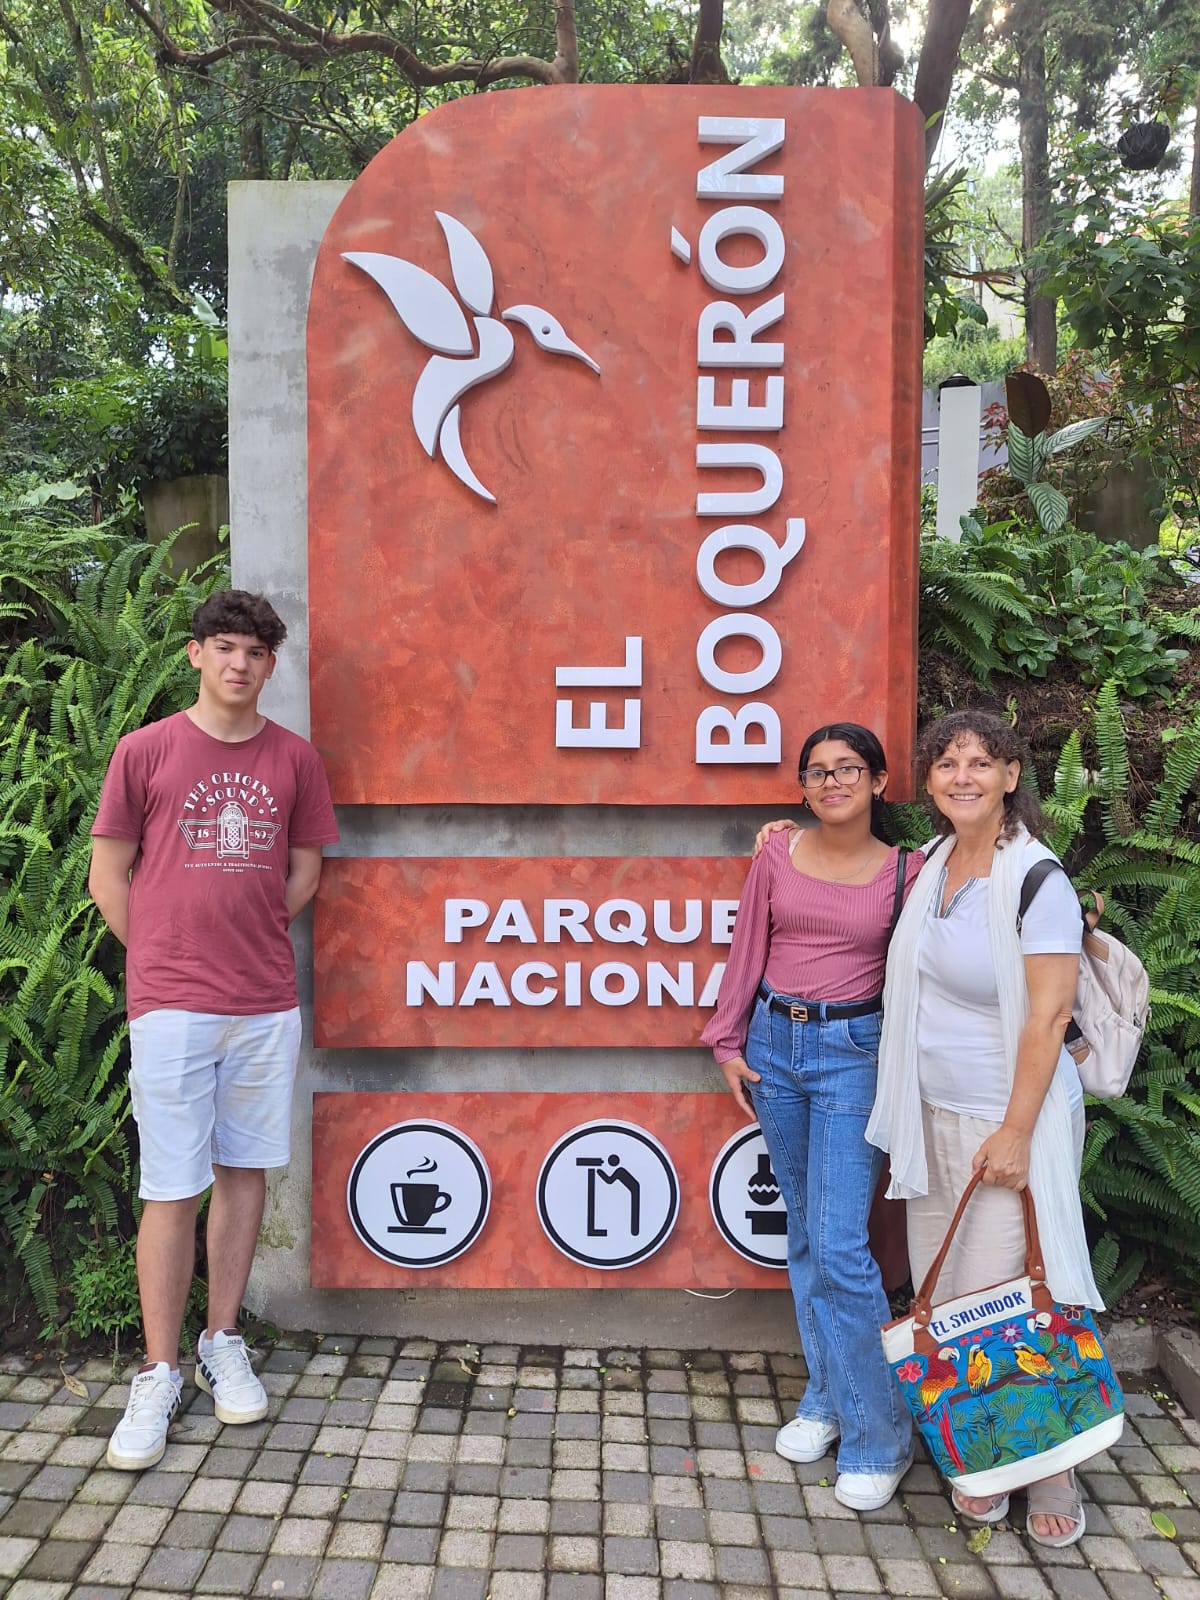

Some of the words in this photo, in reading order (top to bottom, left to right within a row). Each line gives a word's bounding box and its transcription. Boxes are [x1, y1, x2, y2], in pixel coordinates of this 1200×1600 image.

[671, 116, 806, 764] BOQUERÓN
[556, 636, 643, 748] EL
[183, 781, 208, 811] THE
[211, 772, 279, 817] ORIGINAL
[206, 787, 259, 807] SOUND
[445, 899, 740, 946] PARQUE
[931, 1321, 950, 1337] EL
[950, 1291, 1026, 1329] SALVADOR
